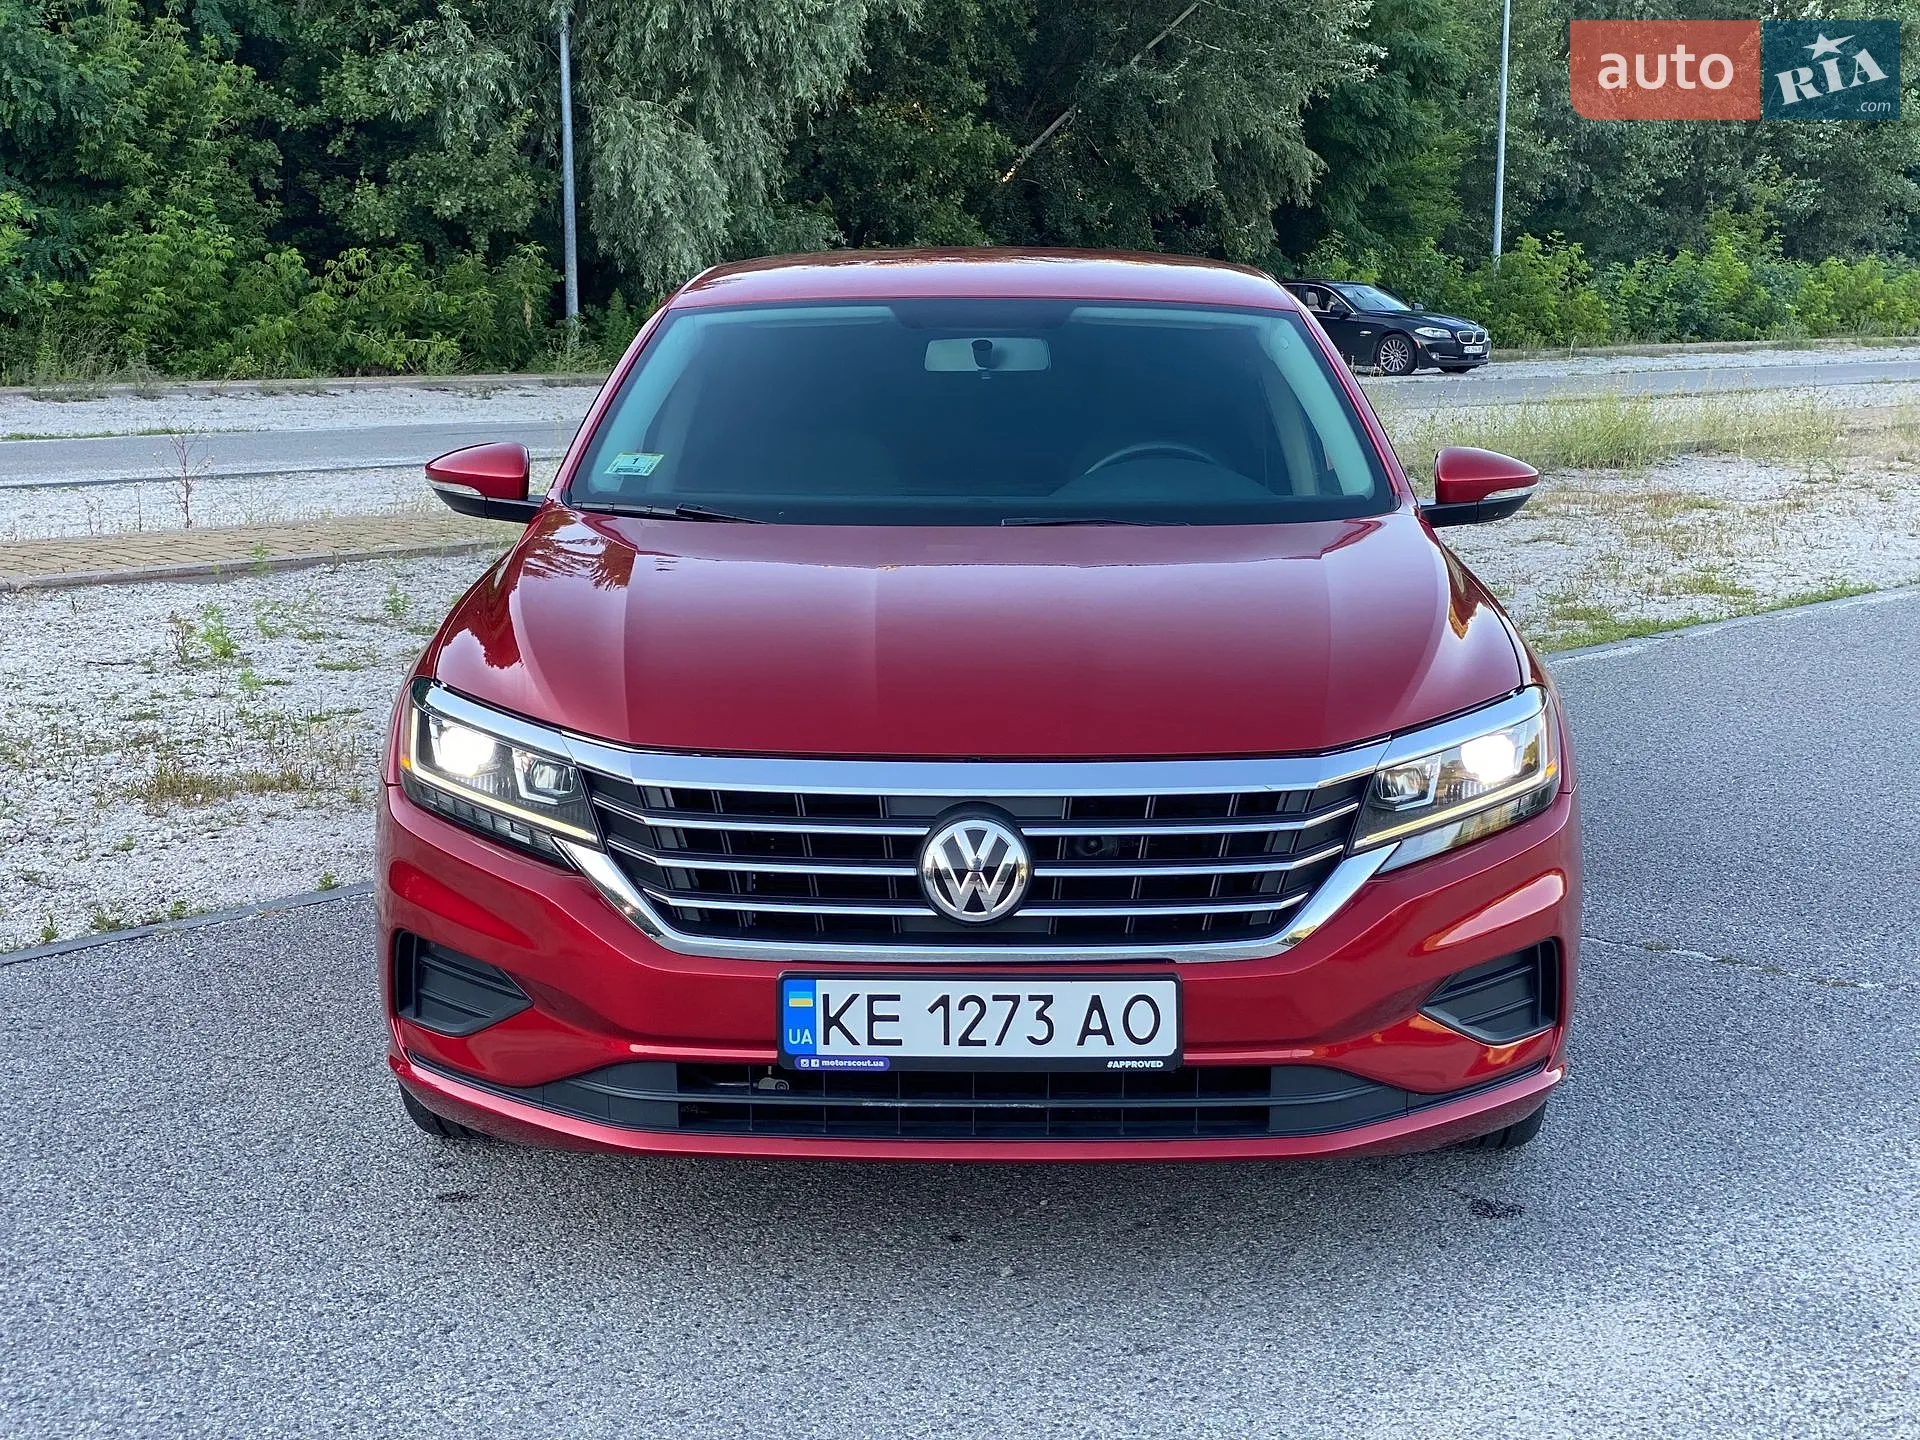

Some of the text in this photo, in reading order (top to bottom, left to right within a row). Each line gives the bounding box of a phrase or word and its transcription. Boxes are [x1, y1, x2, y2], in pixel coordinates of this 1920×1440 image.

[822, 993, 1161, 1047] KE 1273 AO
[788, 1028, 813, 1045] UA
[821, 1059, 884, 1067] motorscout.ua
[1107, 1060, 1164, 1068] #APPROVED
